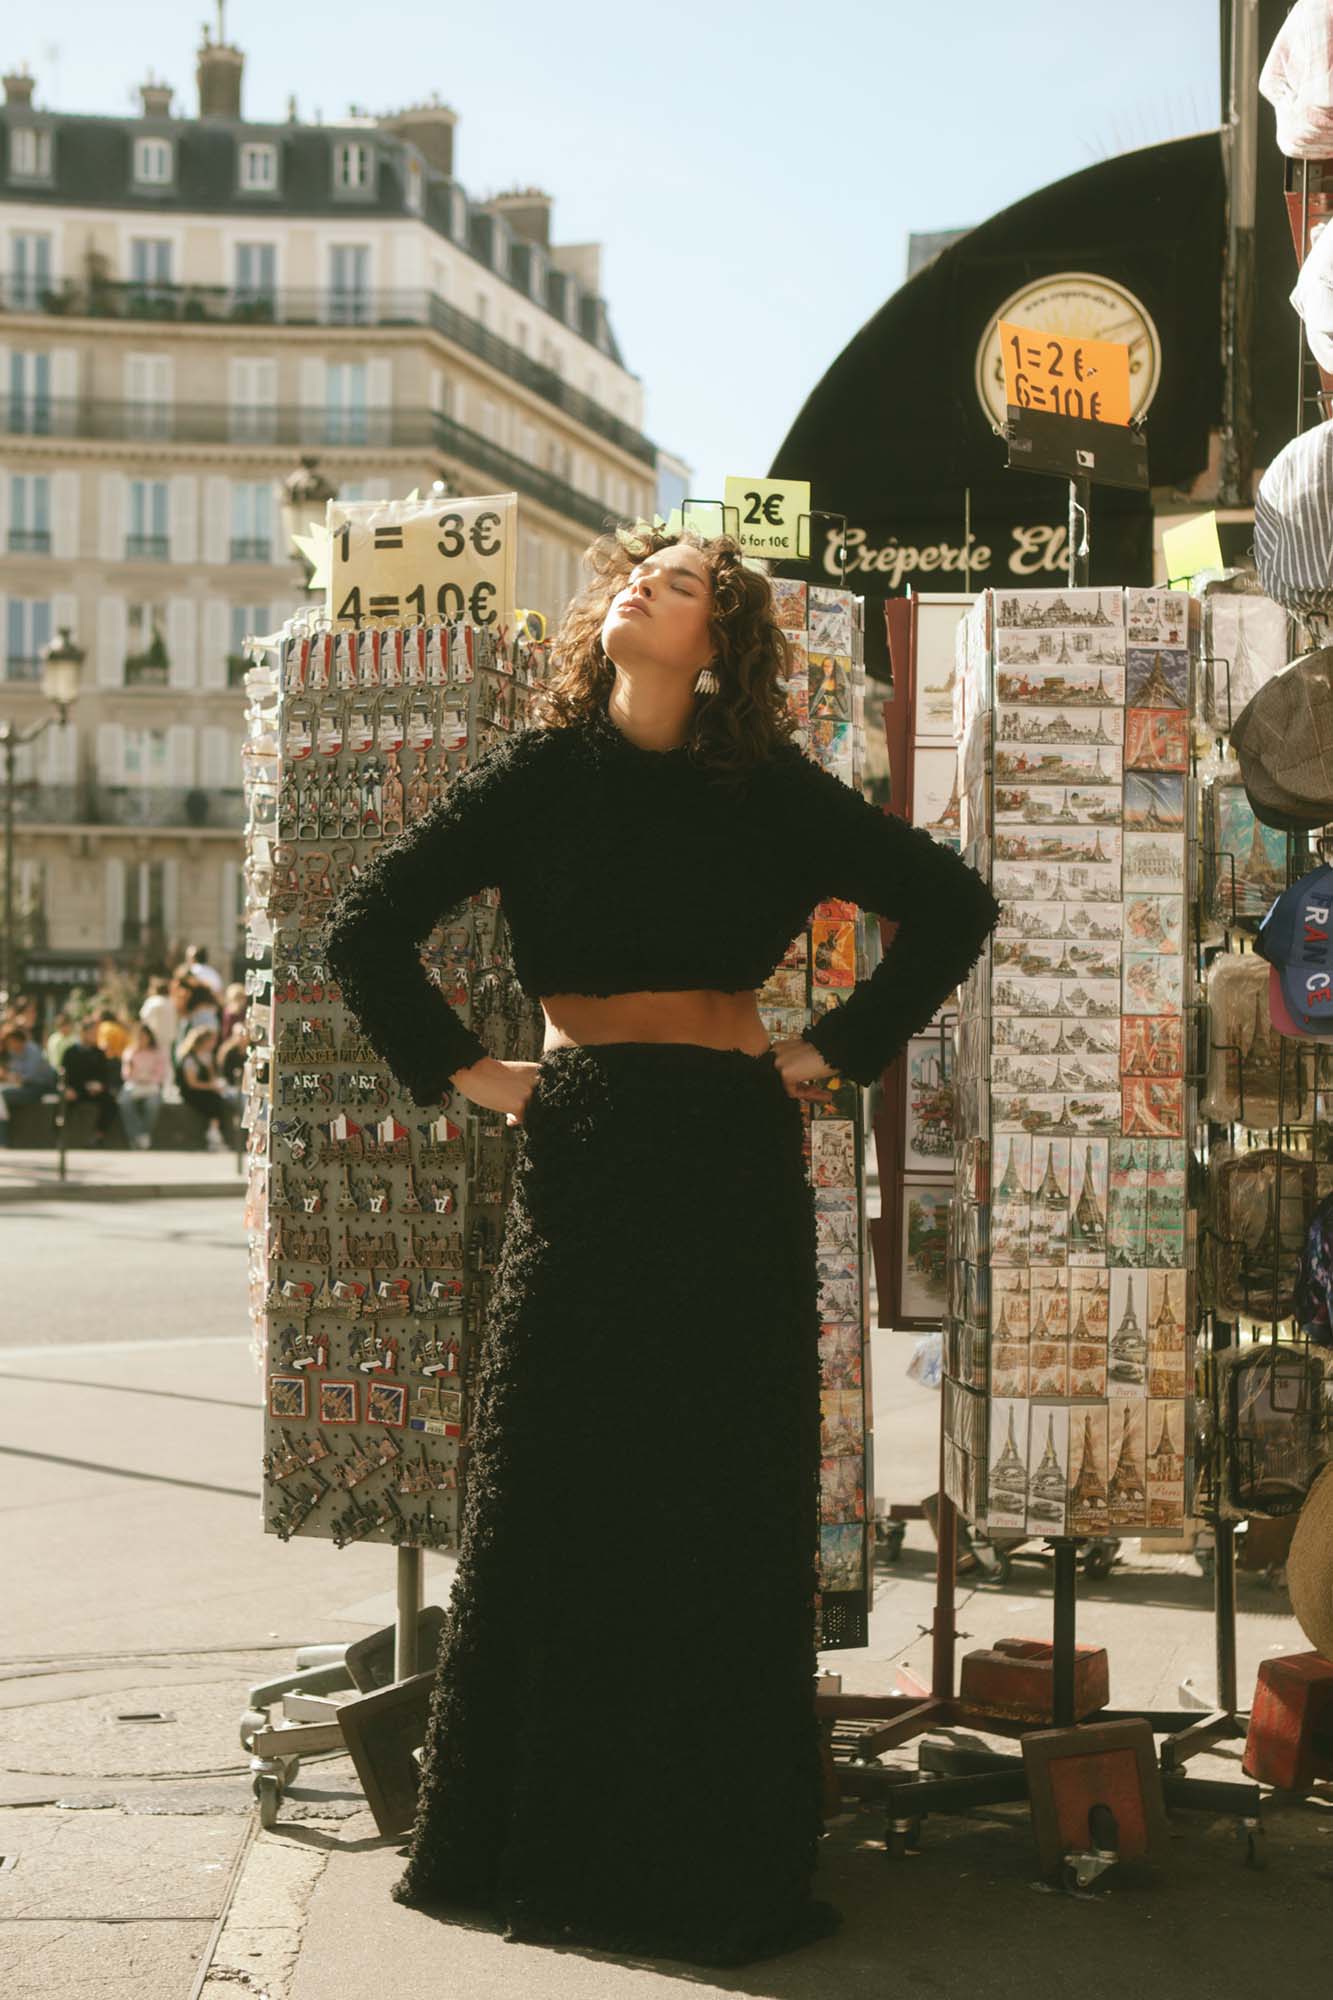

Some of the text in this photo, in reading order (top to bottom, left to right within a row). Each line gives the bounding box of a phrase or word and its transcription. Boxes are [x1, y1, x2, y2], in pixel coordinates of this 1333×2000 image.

[744, 492, 785, 526] 2€
[333, 520, 351, 562] 1
[437, 512, 501, 558] 3€
[740, 534, 789, 548] 6 for 10€
[823, 528, 992, 590] Crêperie
[1302, 893, 1333, 1007] FRANCE
